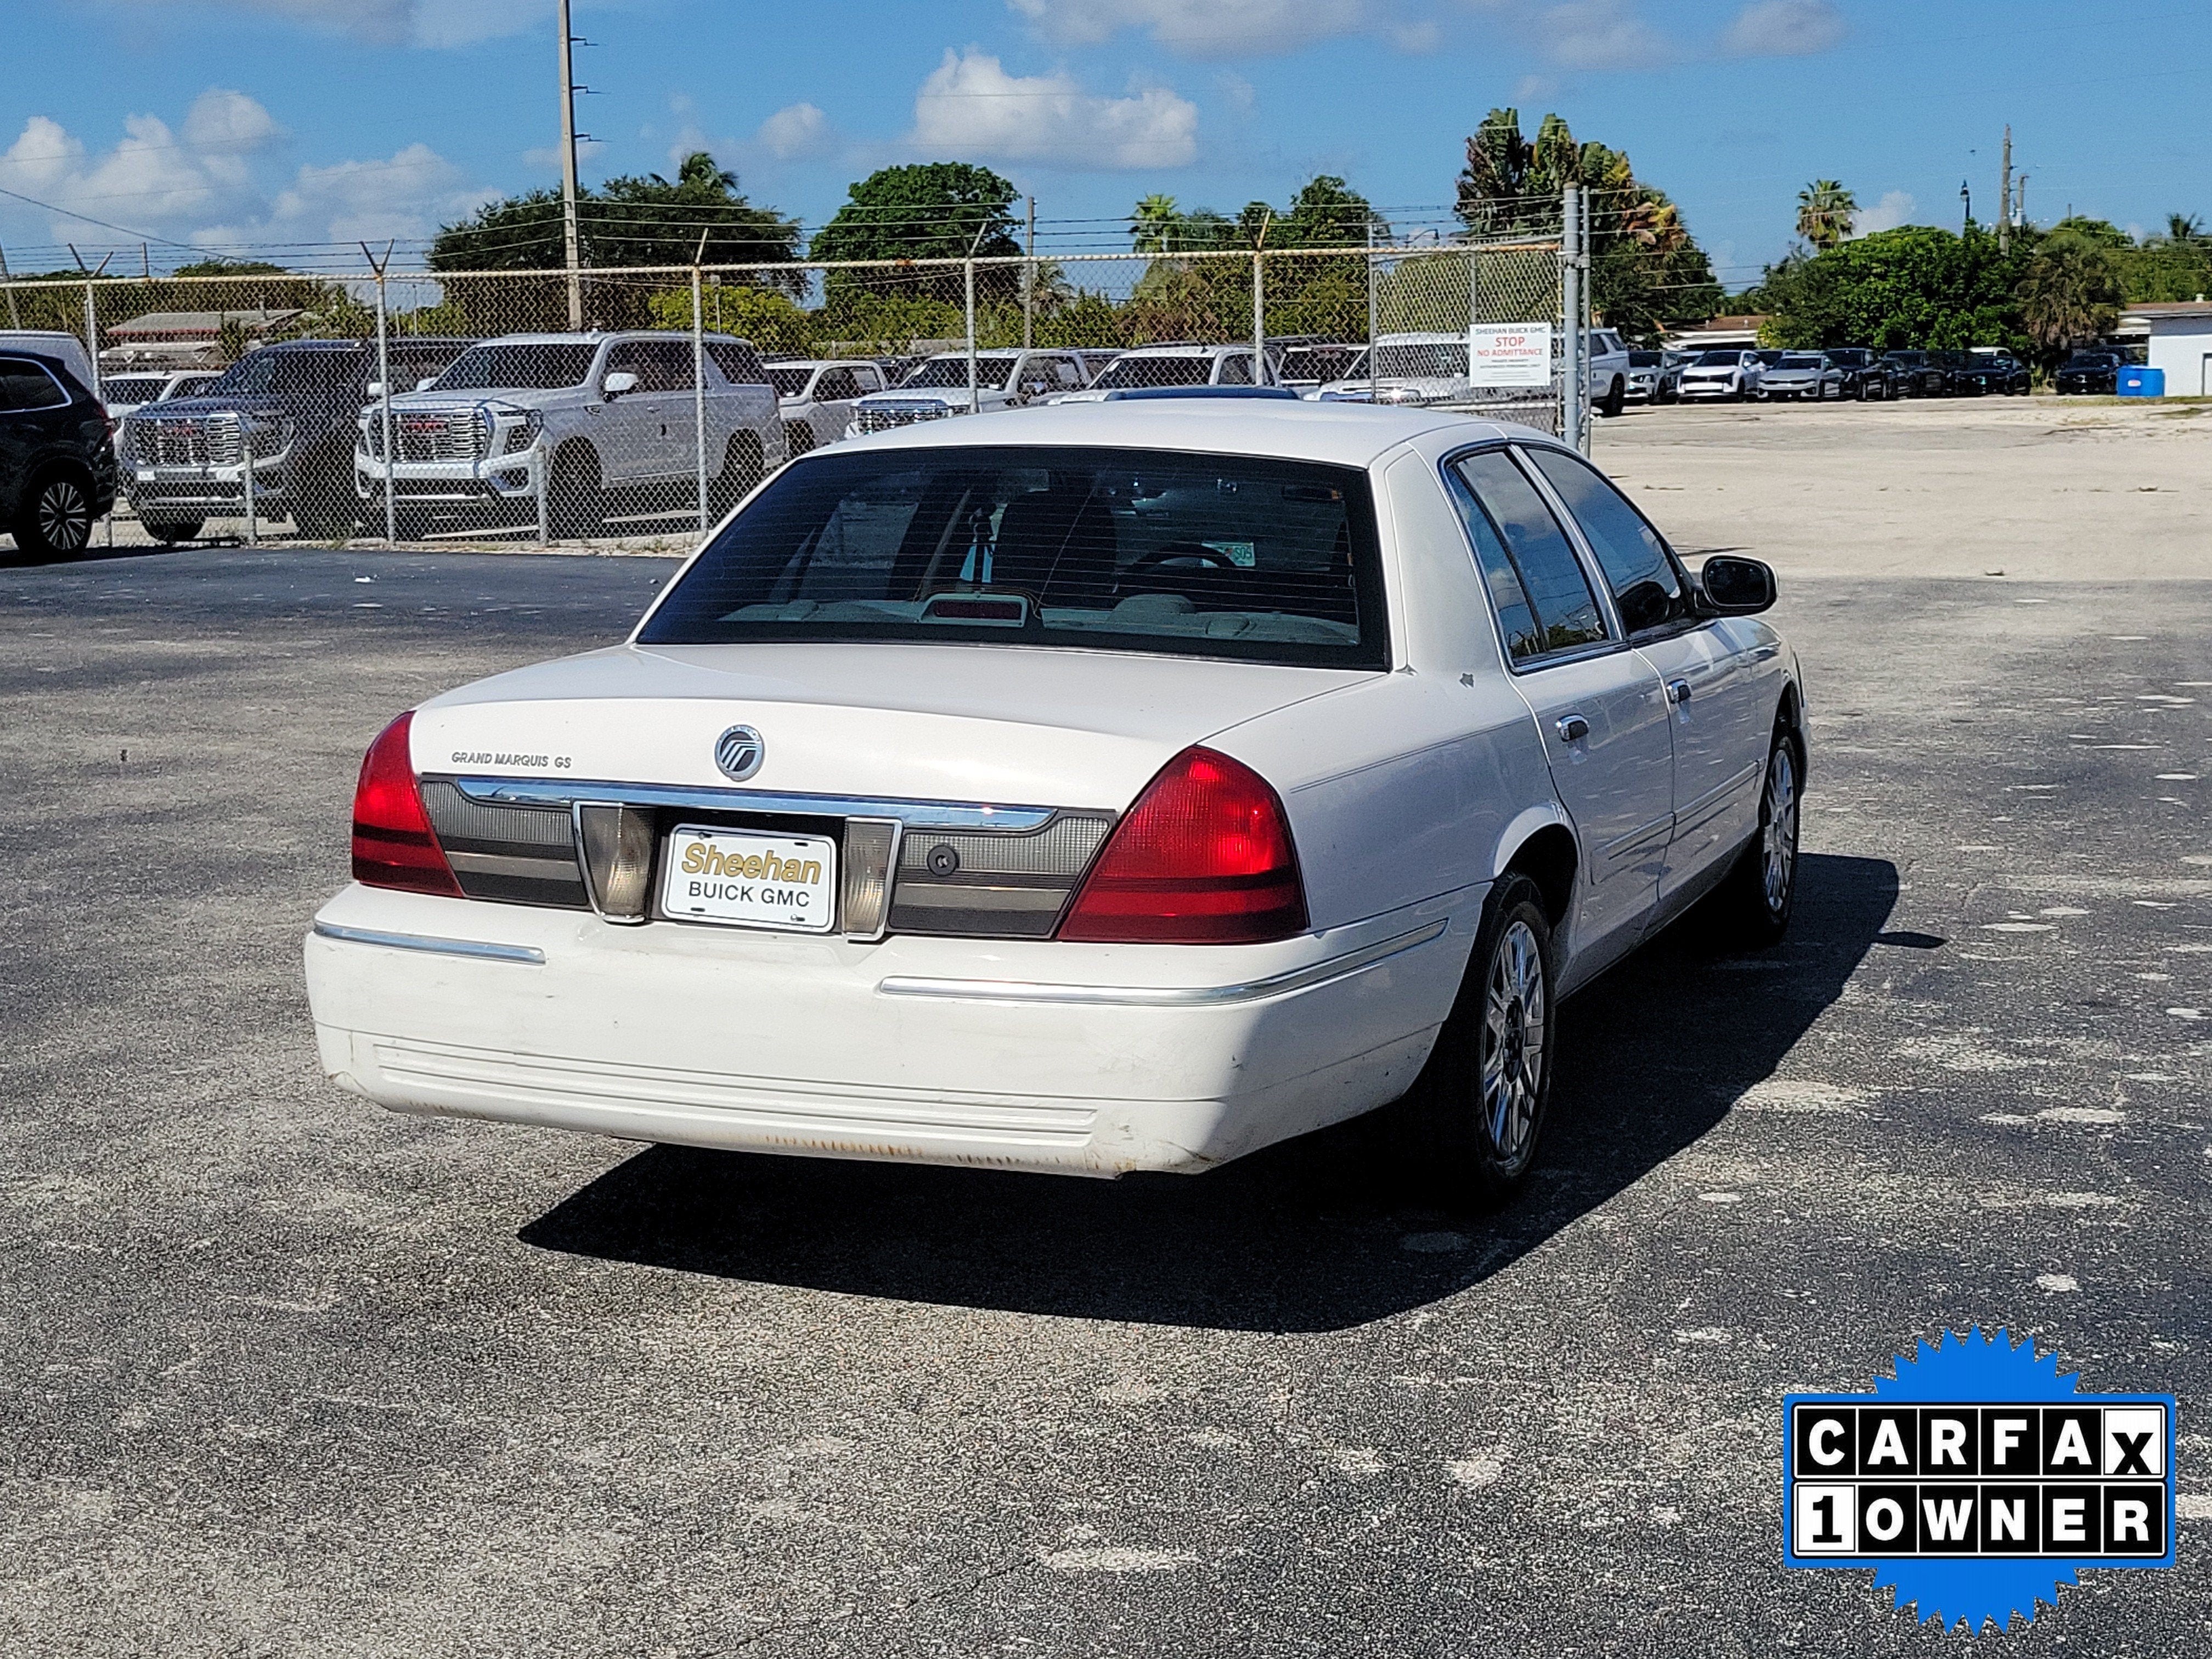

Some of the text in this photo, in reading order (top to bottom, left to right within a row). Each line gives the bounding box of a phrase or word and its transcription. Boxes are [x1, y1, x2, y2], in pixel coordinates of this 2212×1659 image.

[1496, 336, 1525, 347] STOP
[1492, 348, 1543, 357] ADMITTANCE
[452, 752, 572, 768] GRAND MARQUIS GS
[681, 842, 822, 885] Sheehan
[689, 881, 810, 907] BUICK GMC
